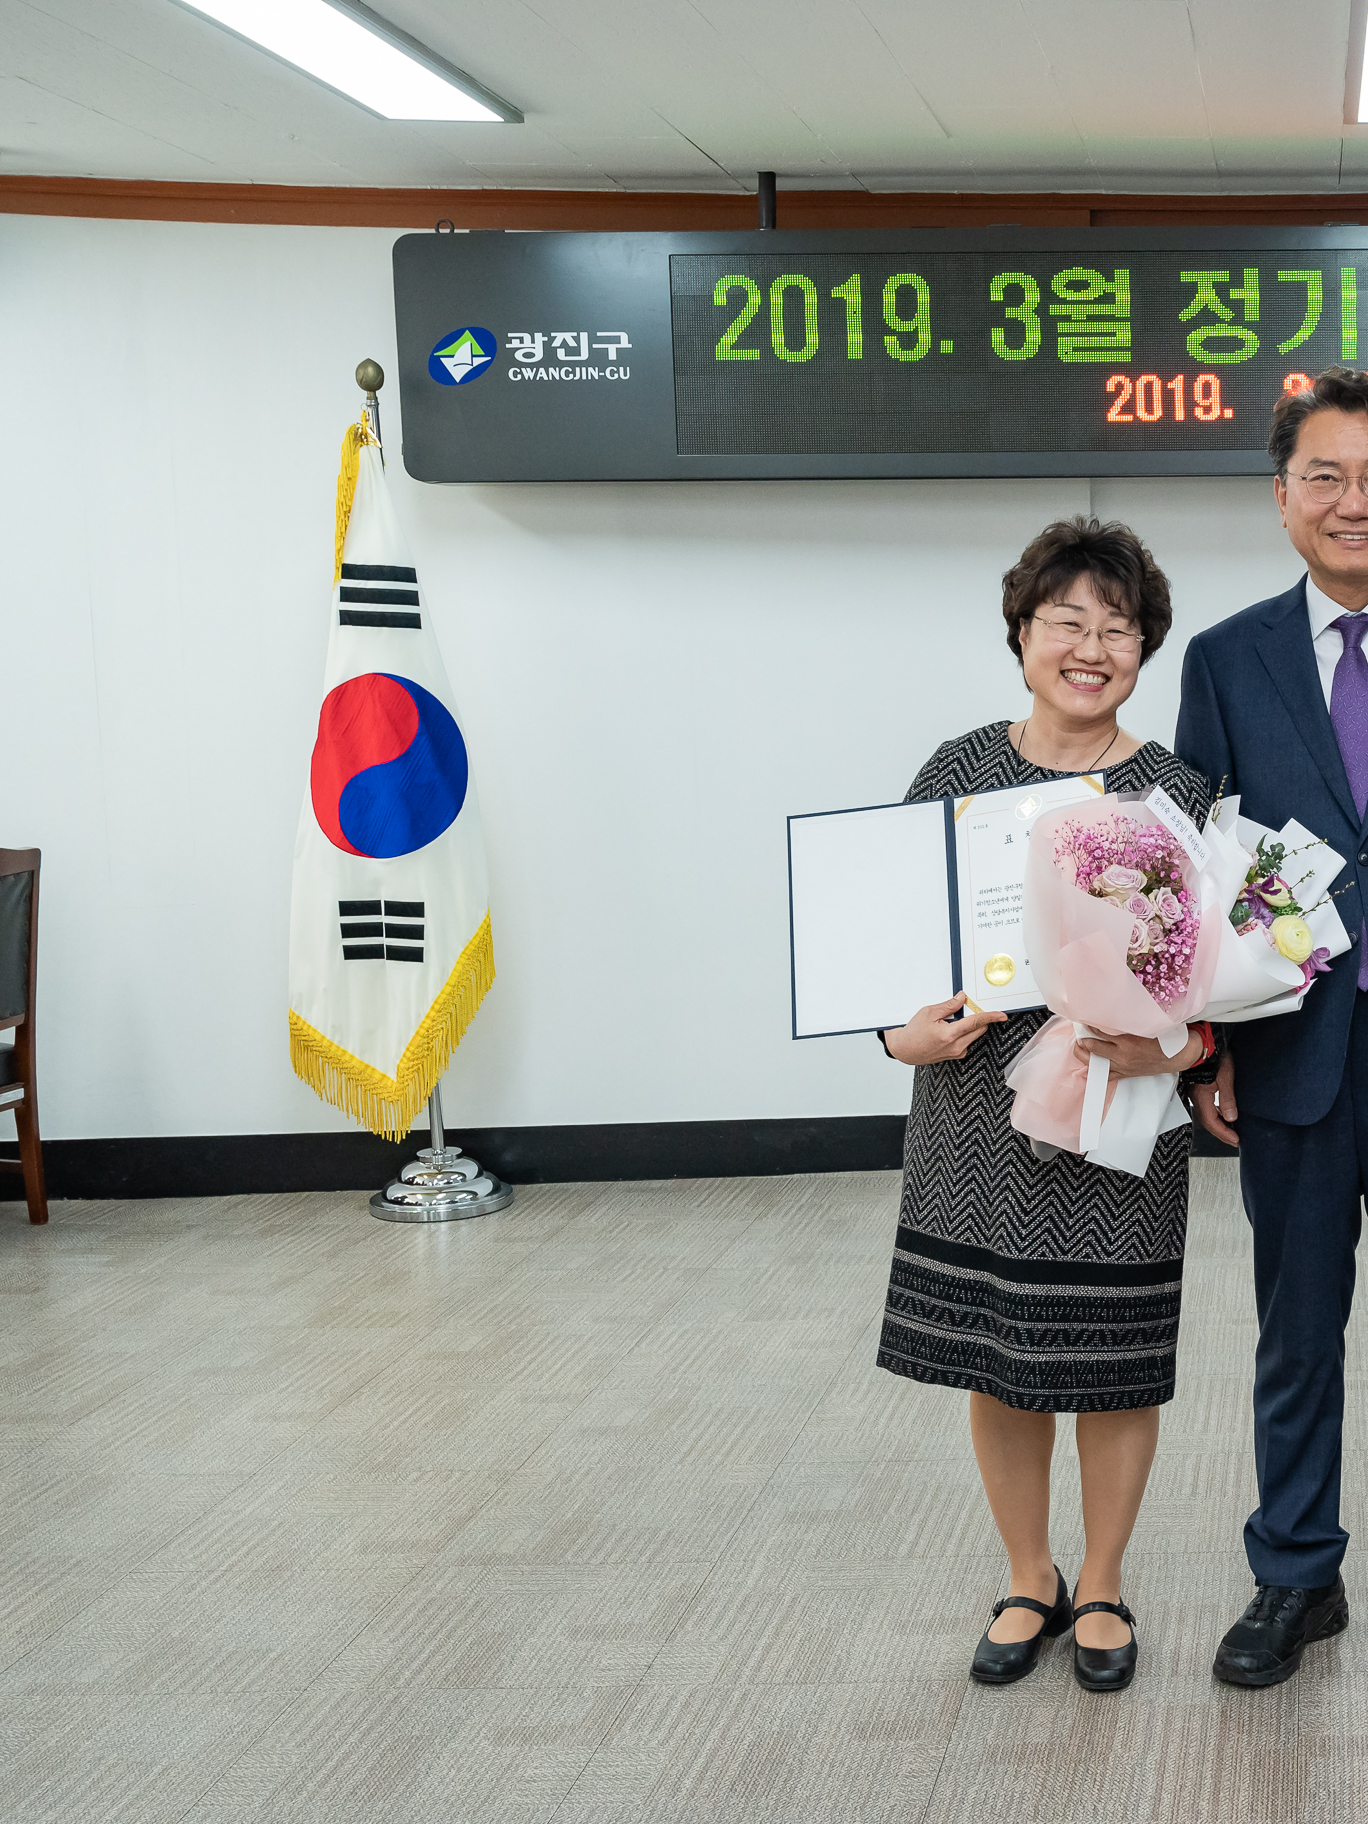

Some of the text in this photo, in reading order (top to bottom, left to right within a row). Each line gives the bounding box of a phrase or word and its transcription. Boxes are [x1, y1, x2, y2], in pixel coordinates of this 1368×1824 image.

[714, 273, 953, 362] 2019.
[989, 266, 1133, 363] 3월
[1178, 266, 1357, 364] 정기
[506, 331, 632, 363] 광진구
[508, 366, 630, 381] GWANGJIN-GU
[1105, 374, 1233, 422] 2019.
